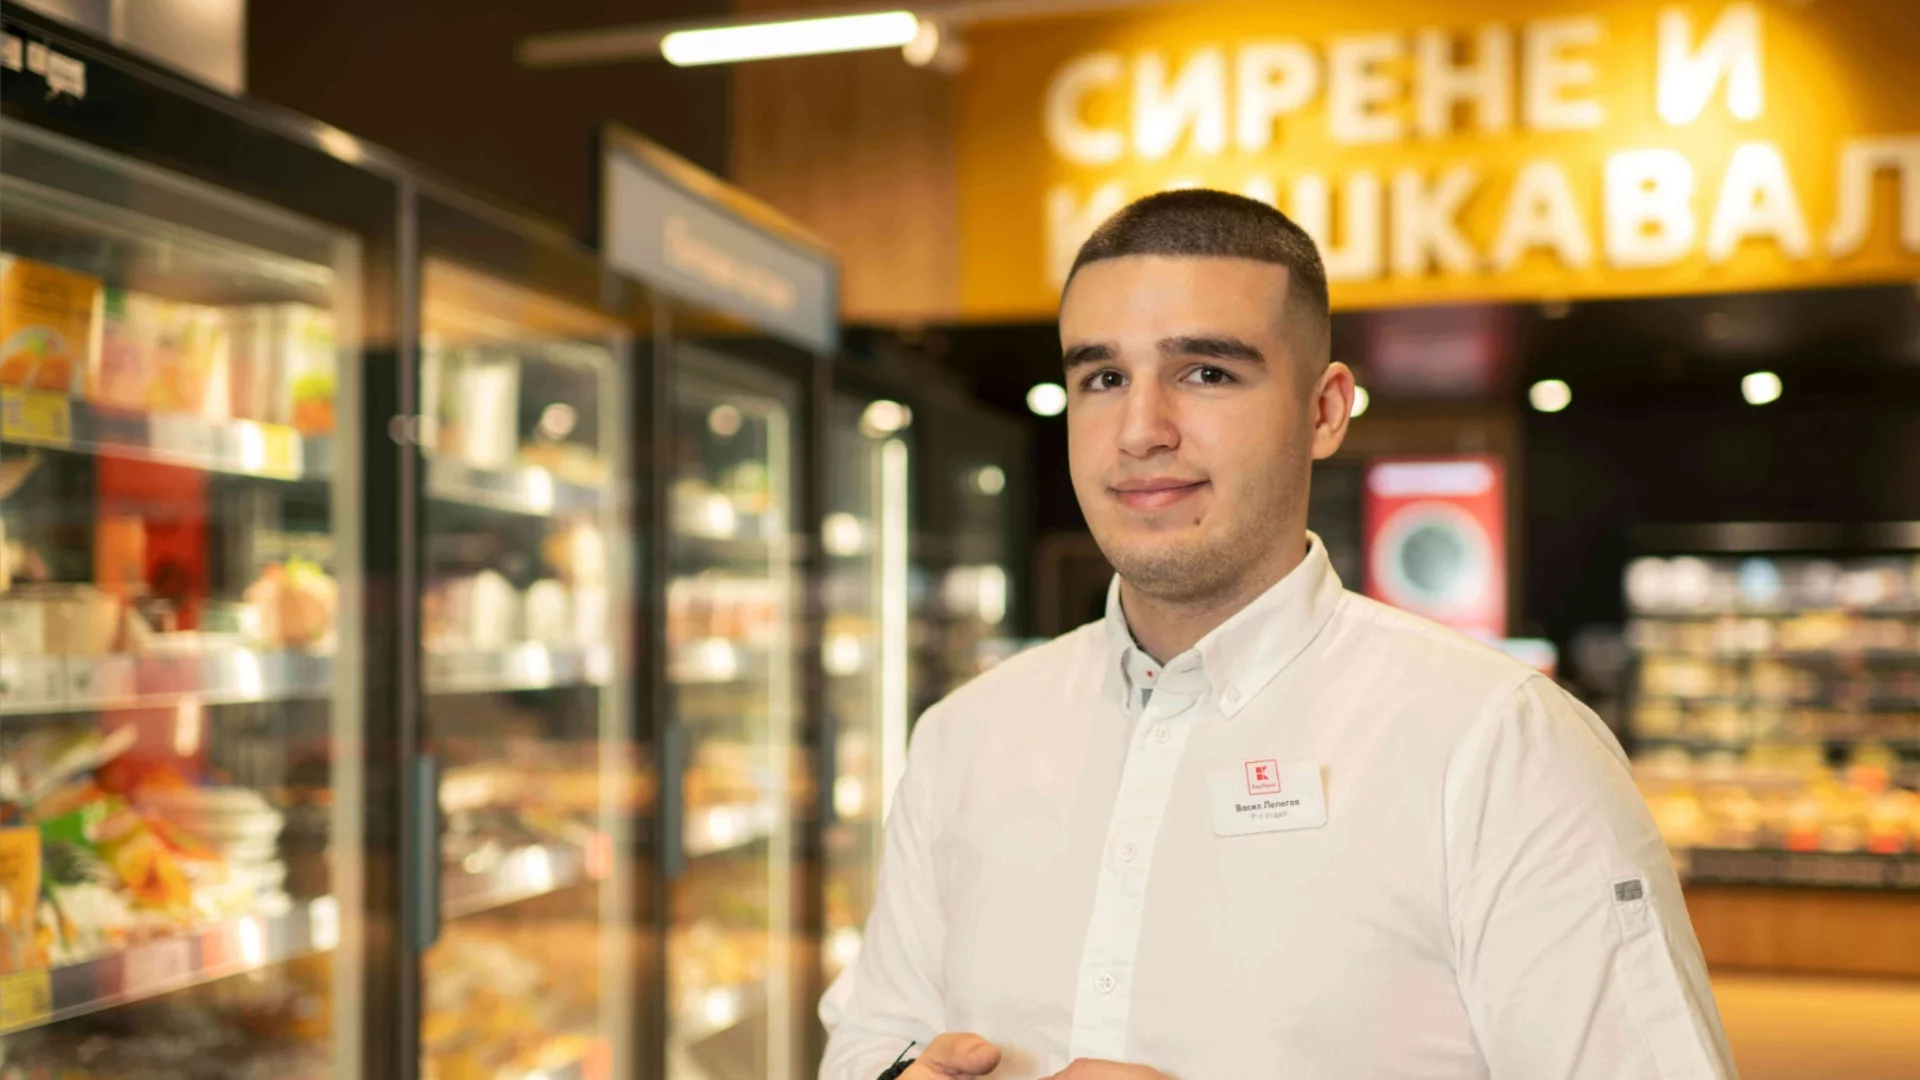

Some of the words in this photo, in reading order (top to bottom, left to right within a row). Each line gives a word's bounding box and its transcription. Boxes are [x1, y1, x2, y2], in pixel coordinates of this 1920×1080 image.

[1045, 19, 1607, 164] СИРЕНЕ
[1655, 3, 1764, 125] И
[1235, 803, 1262, 812] Васил
